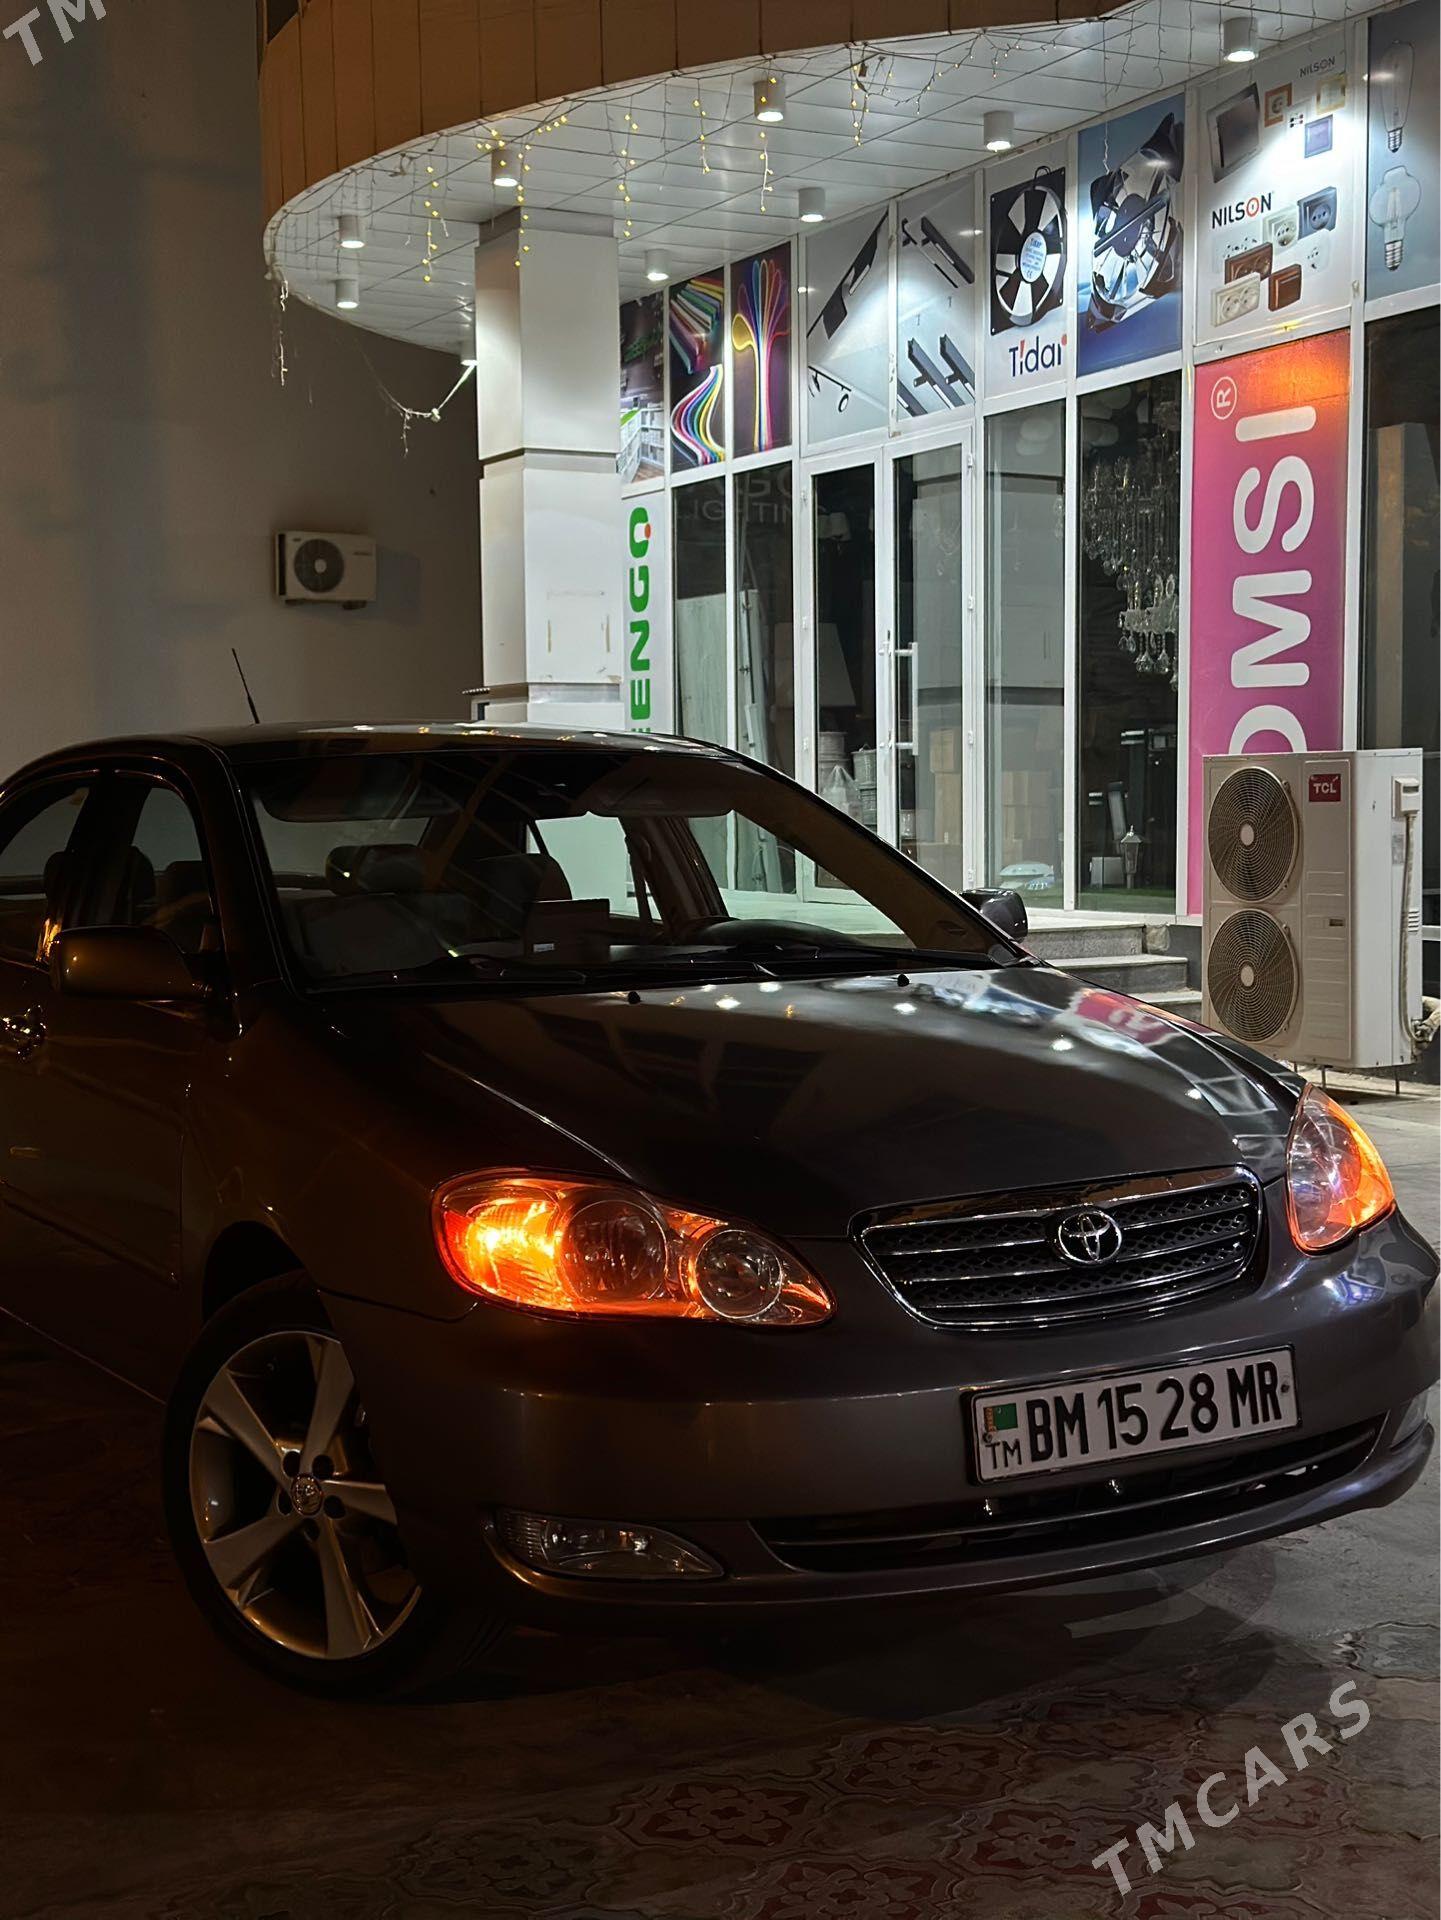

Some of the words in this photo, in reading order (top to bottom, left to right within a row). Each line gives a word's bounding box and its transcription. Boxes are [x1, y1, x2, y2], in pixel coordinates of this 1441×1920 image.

[1299, 55, 1336, 78] NILSON
[1211, 192, 1272, 229] NILSON
[629, 506, 651, 732] ENGO
[1313, 782, 1337, 794] TCL
[985, 1440, 1023, 1470] TM
